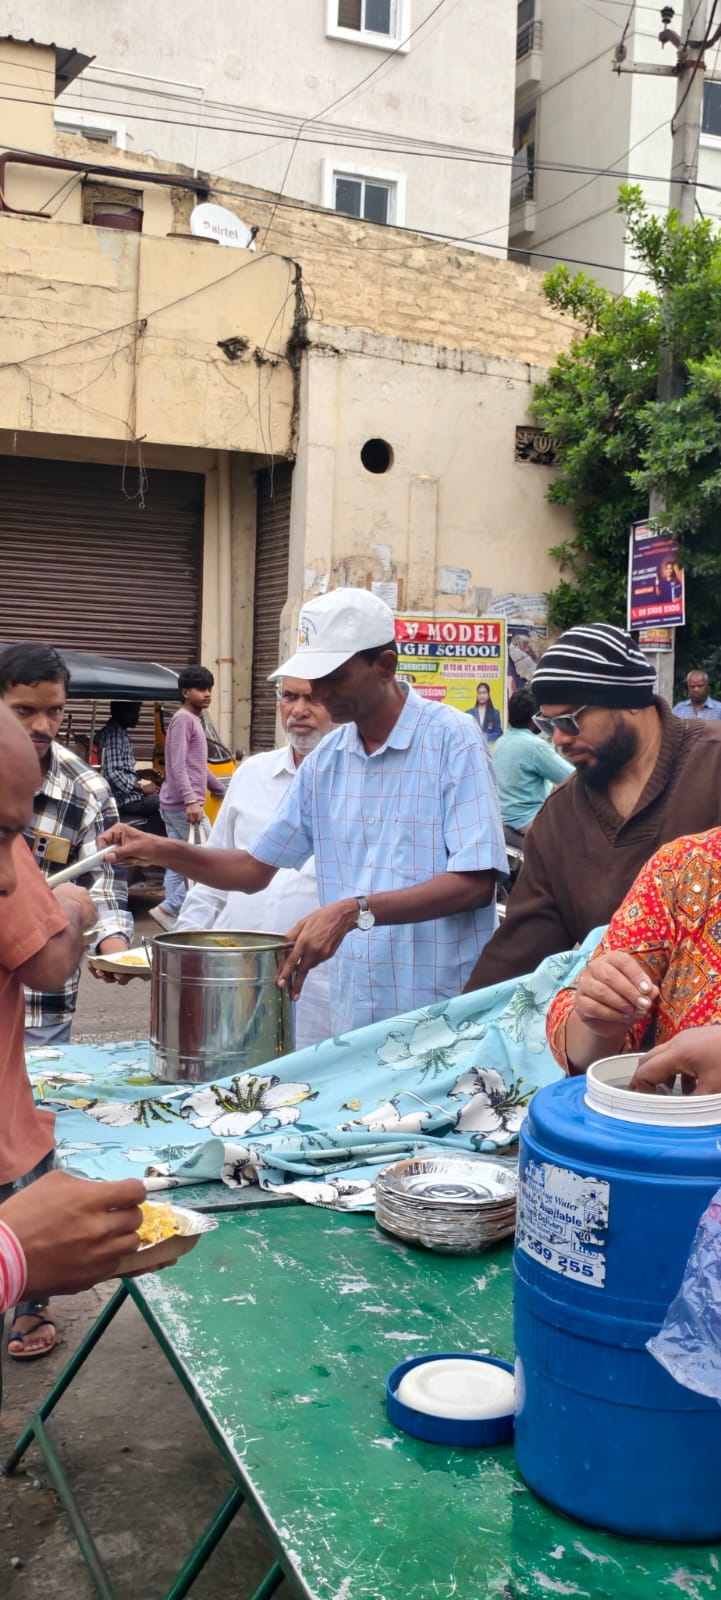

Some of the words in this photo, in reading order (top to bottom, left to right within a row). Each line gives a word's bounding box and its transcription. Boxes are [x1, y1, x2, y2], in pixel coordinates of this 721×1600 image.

[211, 224, 239, 239] airtel
[426, 623, 498, 642] MODEL
[435, 644, 499, 657] SCHOOL
[555, 1196, 579, 1212] Water
[539, 1201, 582, 1227] Available
[558, 1255, 594, 1277] 255
